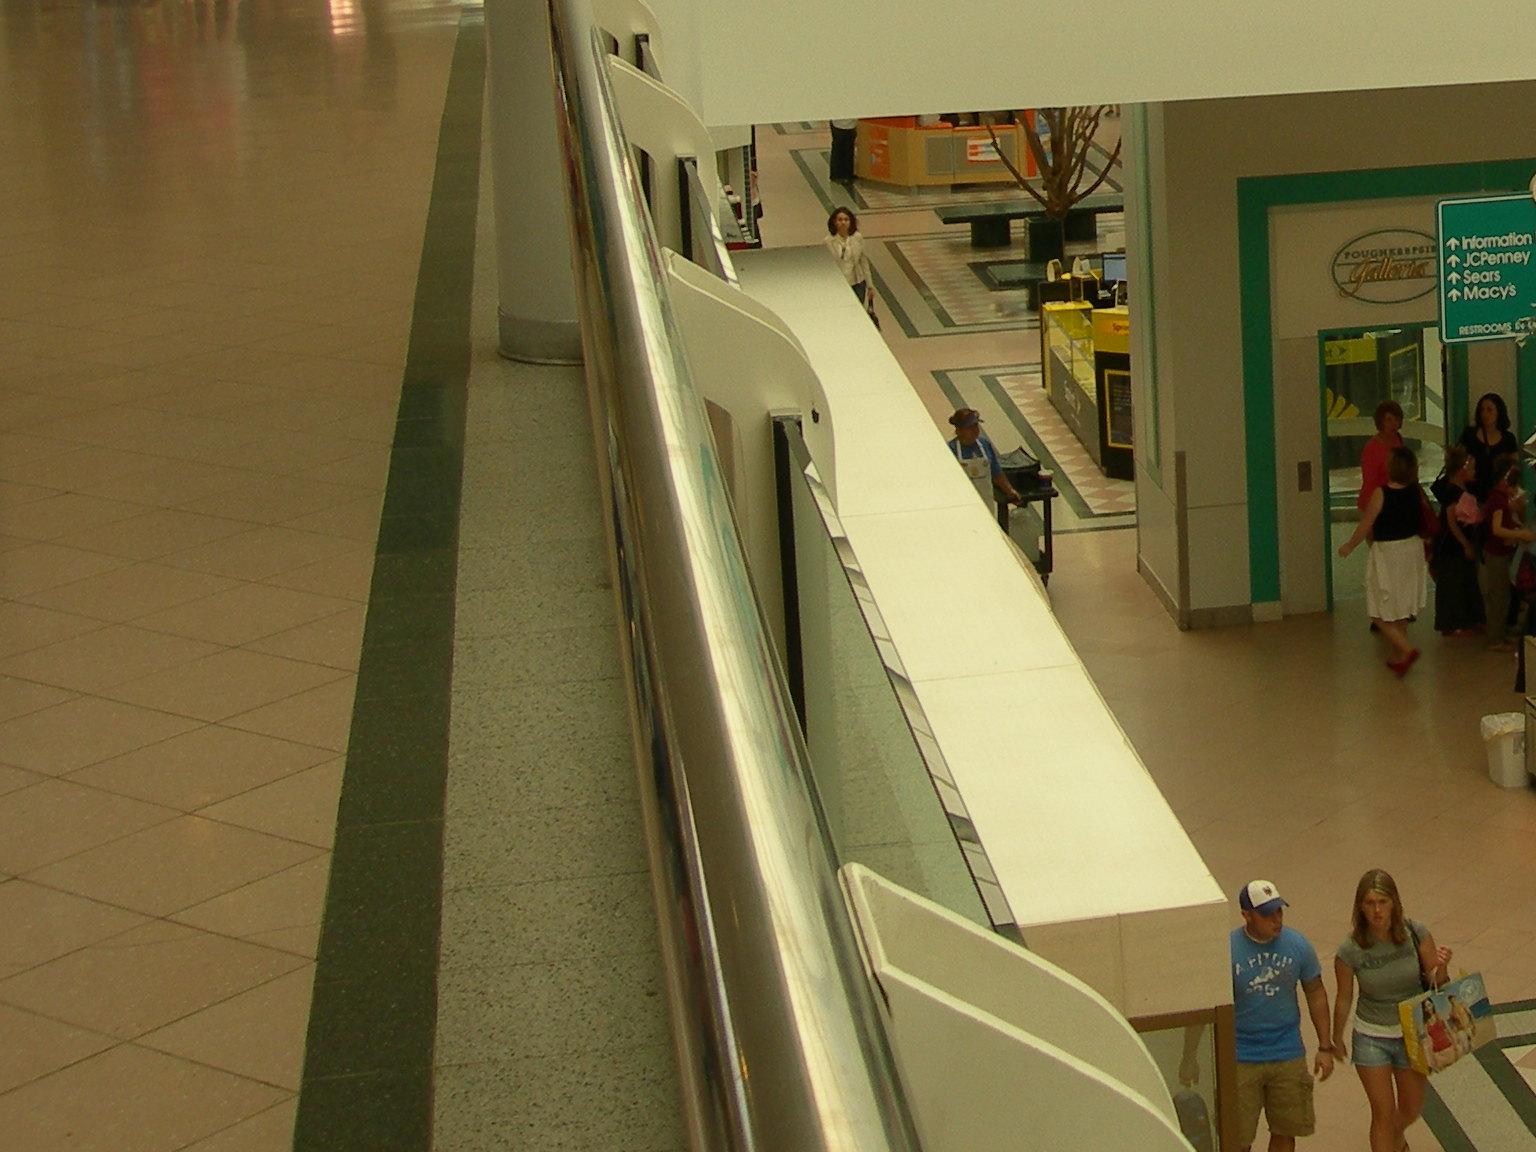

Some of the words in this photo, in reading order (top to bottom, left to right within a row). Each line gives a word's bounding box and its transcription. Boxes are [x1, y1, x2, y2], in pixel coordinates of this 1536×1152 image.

[1461, 232, 1533, 250] Information
[1462, 250, 1531, 268] JCPenney
[1462, 269, 1502, 285] Sears
[1463, 282, 1517, 302] Macy's
[1458, 322, 1512, 336] RESTROOMS
